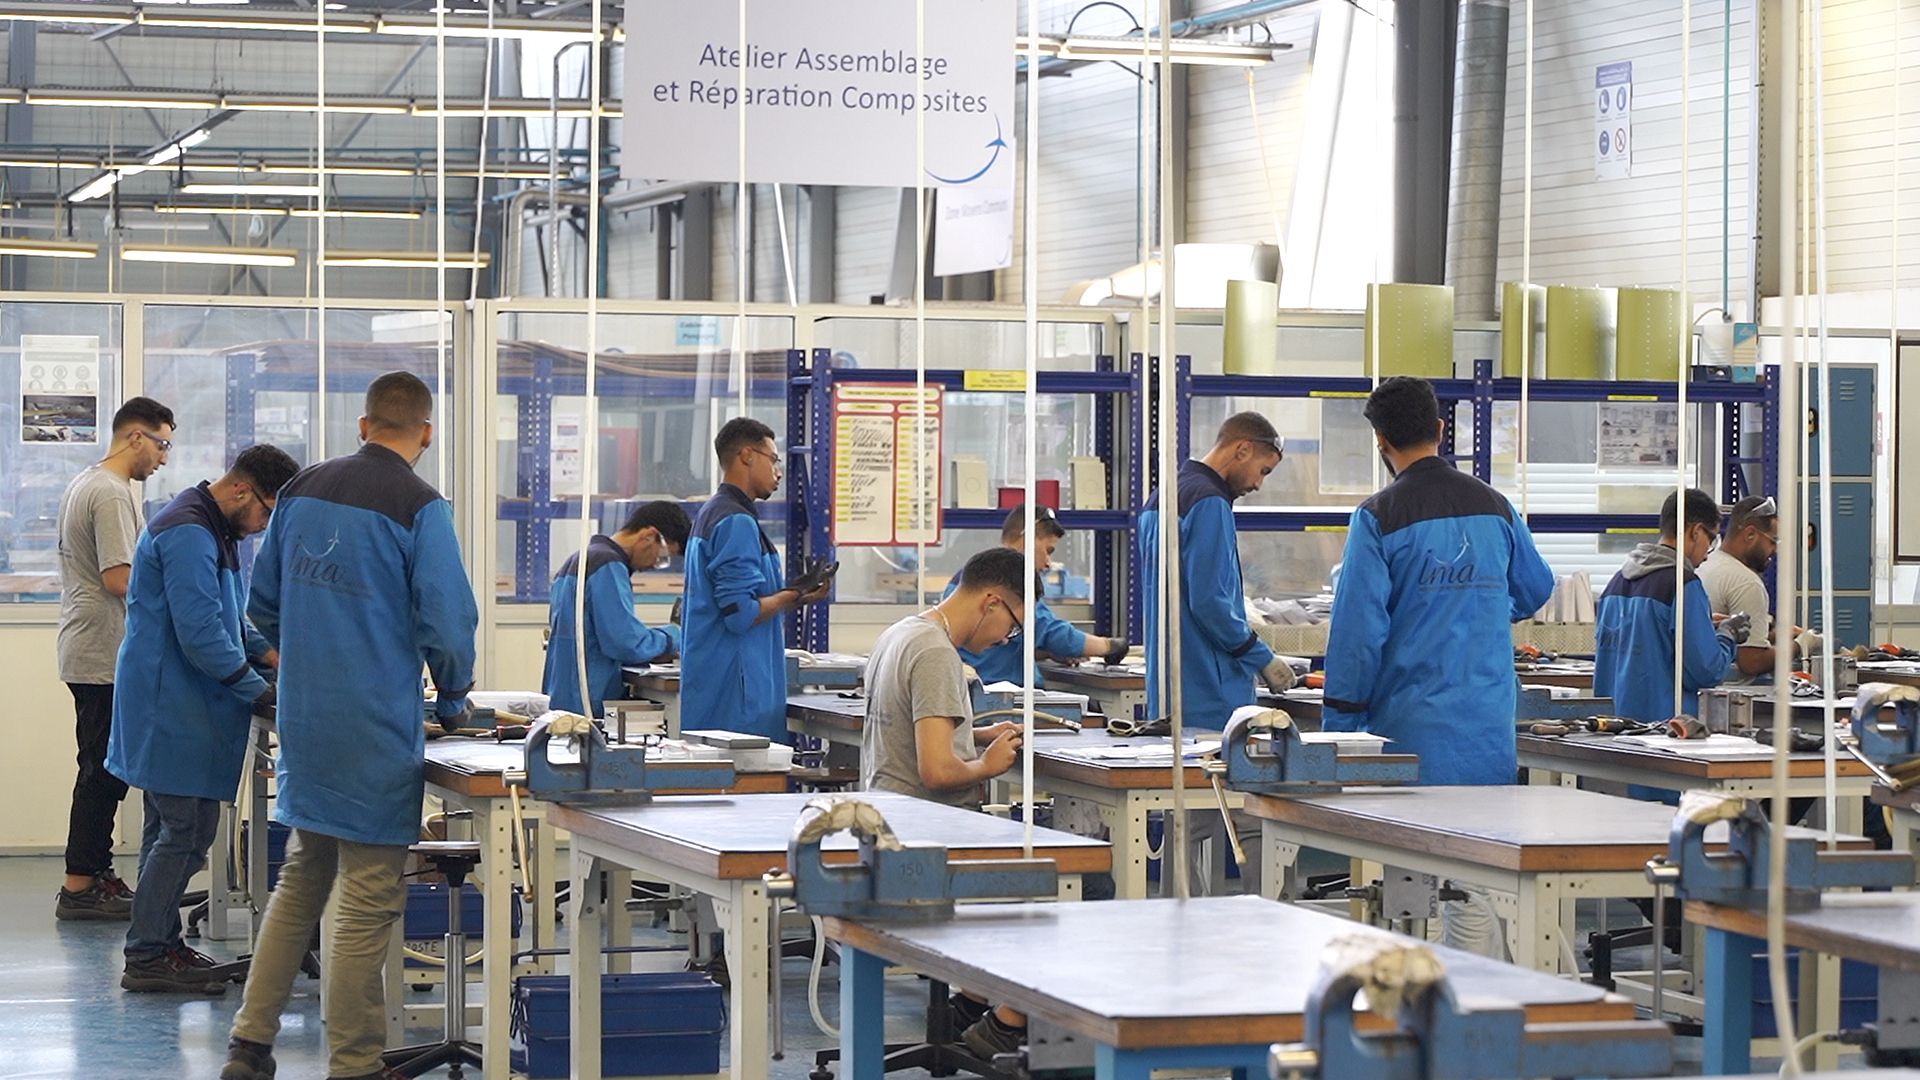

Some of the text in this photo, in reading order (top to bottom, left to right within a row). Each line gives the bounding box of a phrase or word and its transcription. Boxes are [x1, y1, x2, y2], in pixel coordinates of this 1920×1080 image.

[698, 43, 947, 81] Atelier Assemblage
[653, 79, 988, 116] et Réparation Composites
[899, 863, 924, 877] 150
